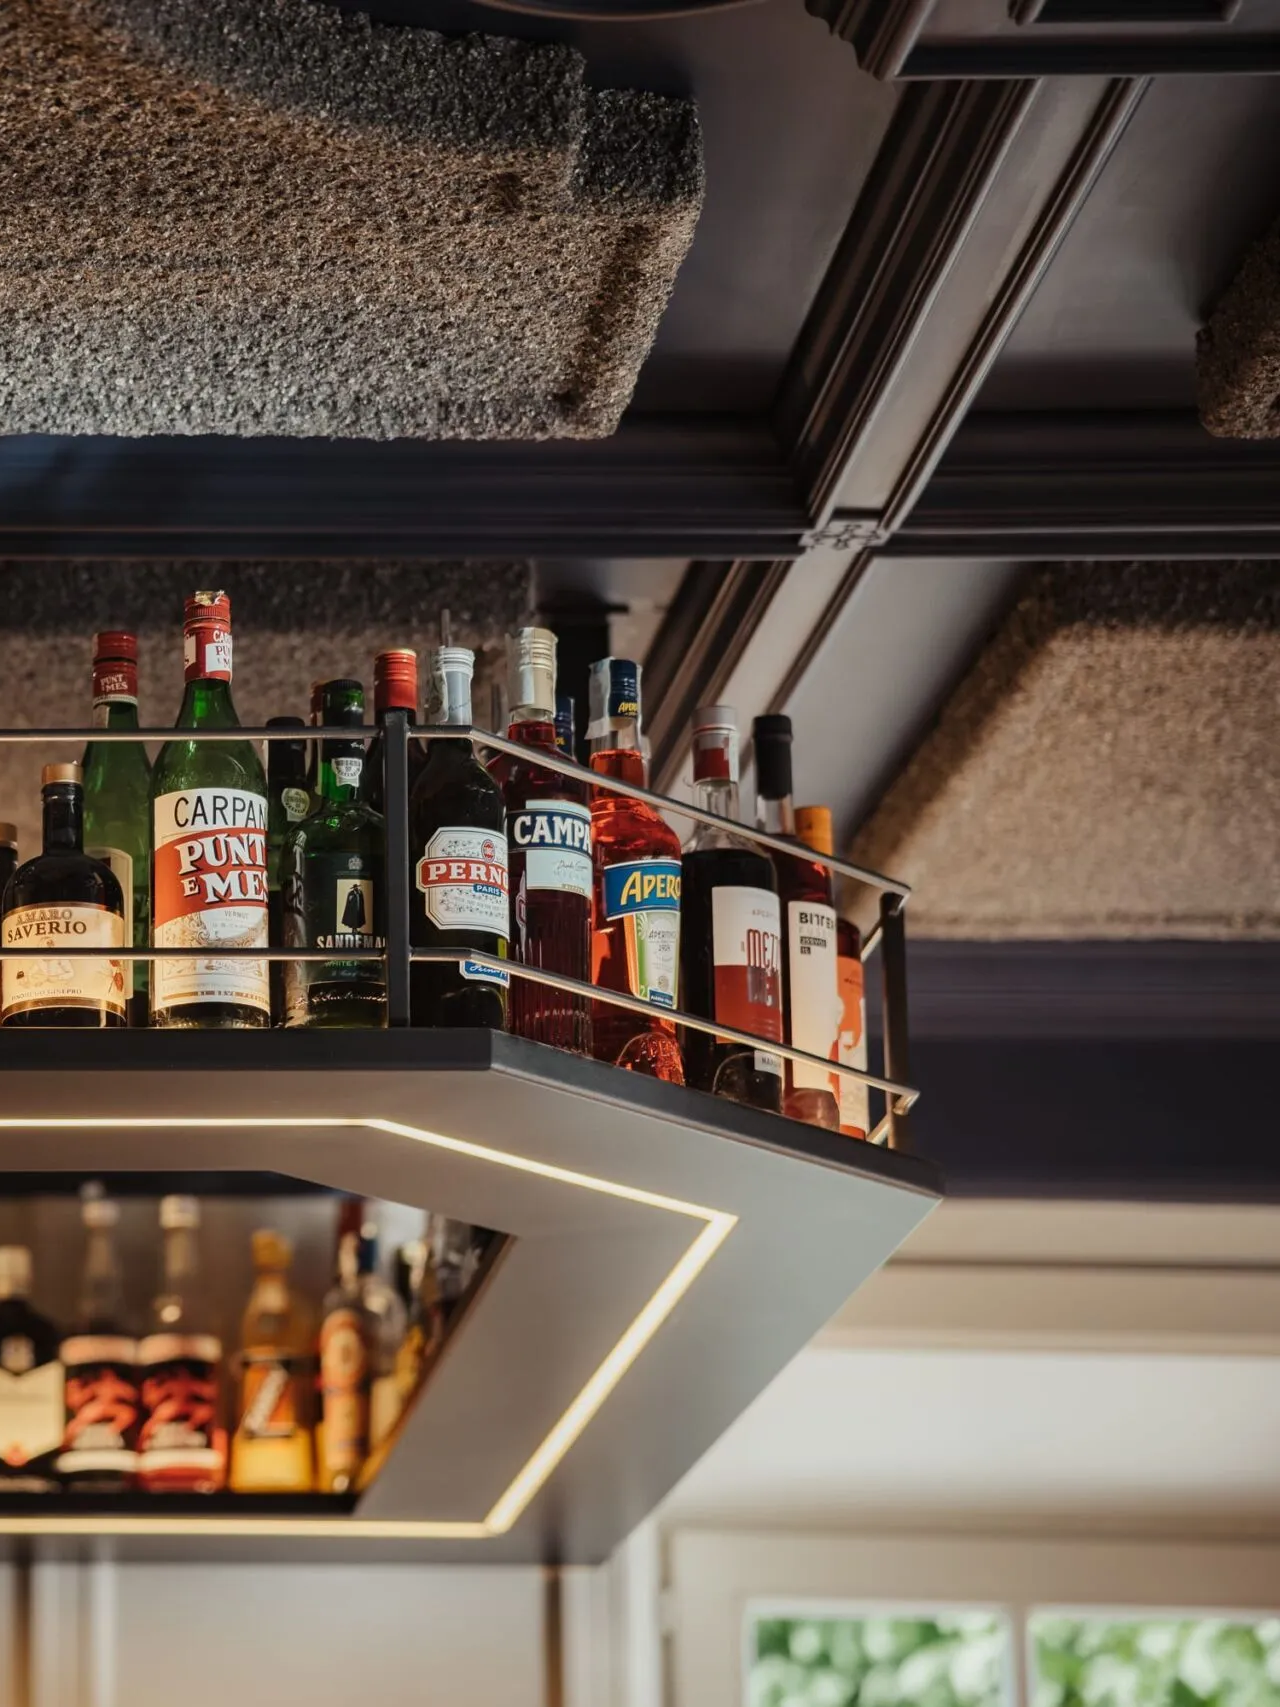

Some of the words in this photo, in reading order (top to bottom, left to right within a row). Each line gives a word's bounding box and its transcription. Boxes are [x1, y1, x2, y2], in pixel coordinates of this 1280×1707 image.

[173, 833, 266, 875] PUNT
[476, 884, 500, 896] PARIS
[15, 908, 74, 926] AMARO
[6, 920, 88, 944] SAVERIO
